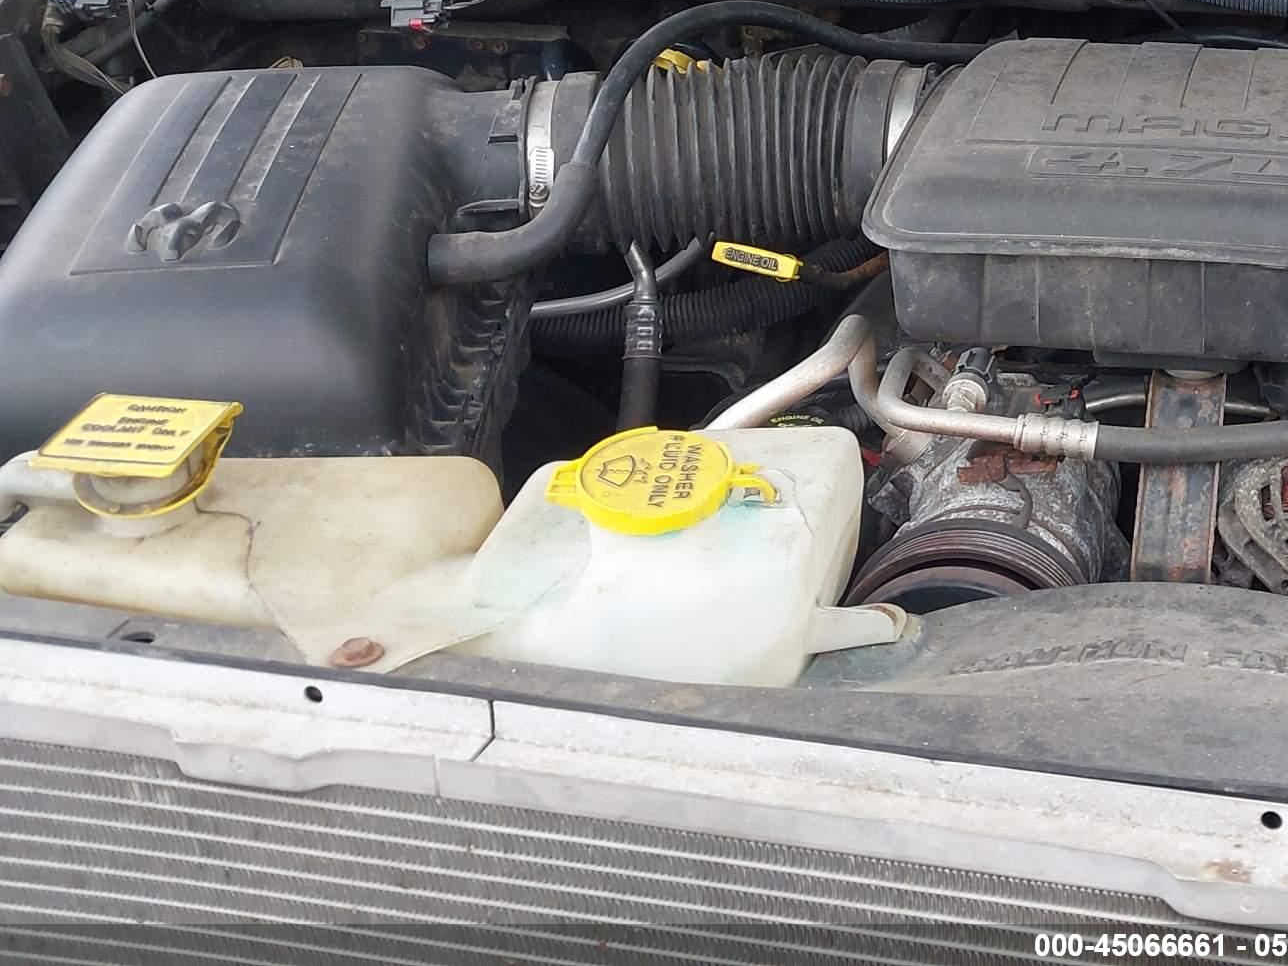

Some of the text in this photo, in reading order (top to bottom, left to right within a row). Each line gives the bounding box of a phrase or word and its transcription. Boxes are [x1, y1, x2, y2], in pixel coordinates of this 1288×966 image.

[724, 248, 778, 270] ENGINE OIL
[81, 423, 190, 437] COOLANT ONLY
[647, 434, 684, 509] FLUID ONLY
[674, 442, 703, 500] WASHER
